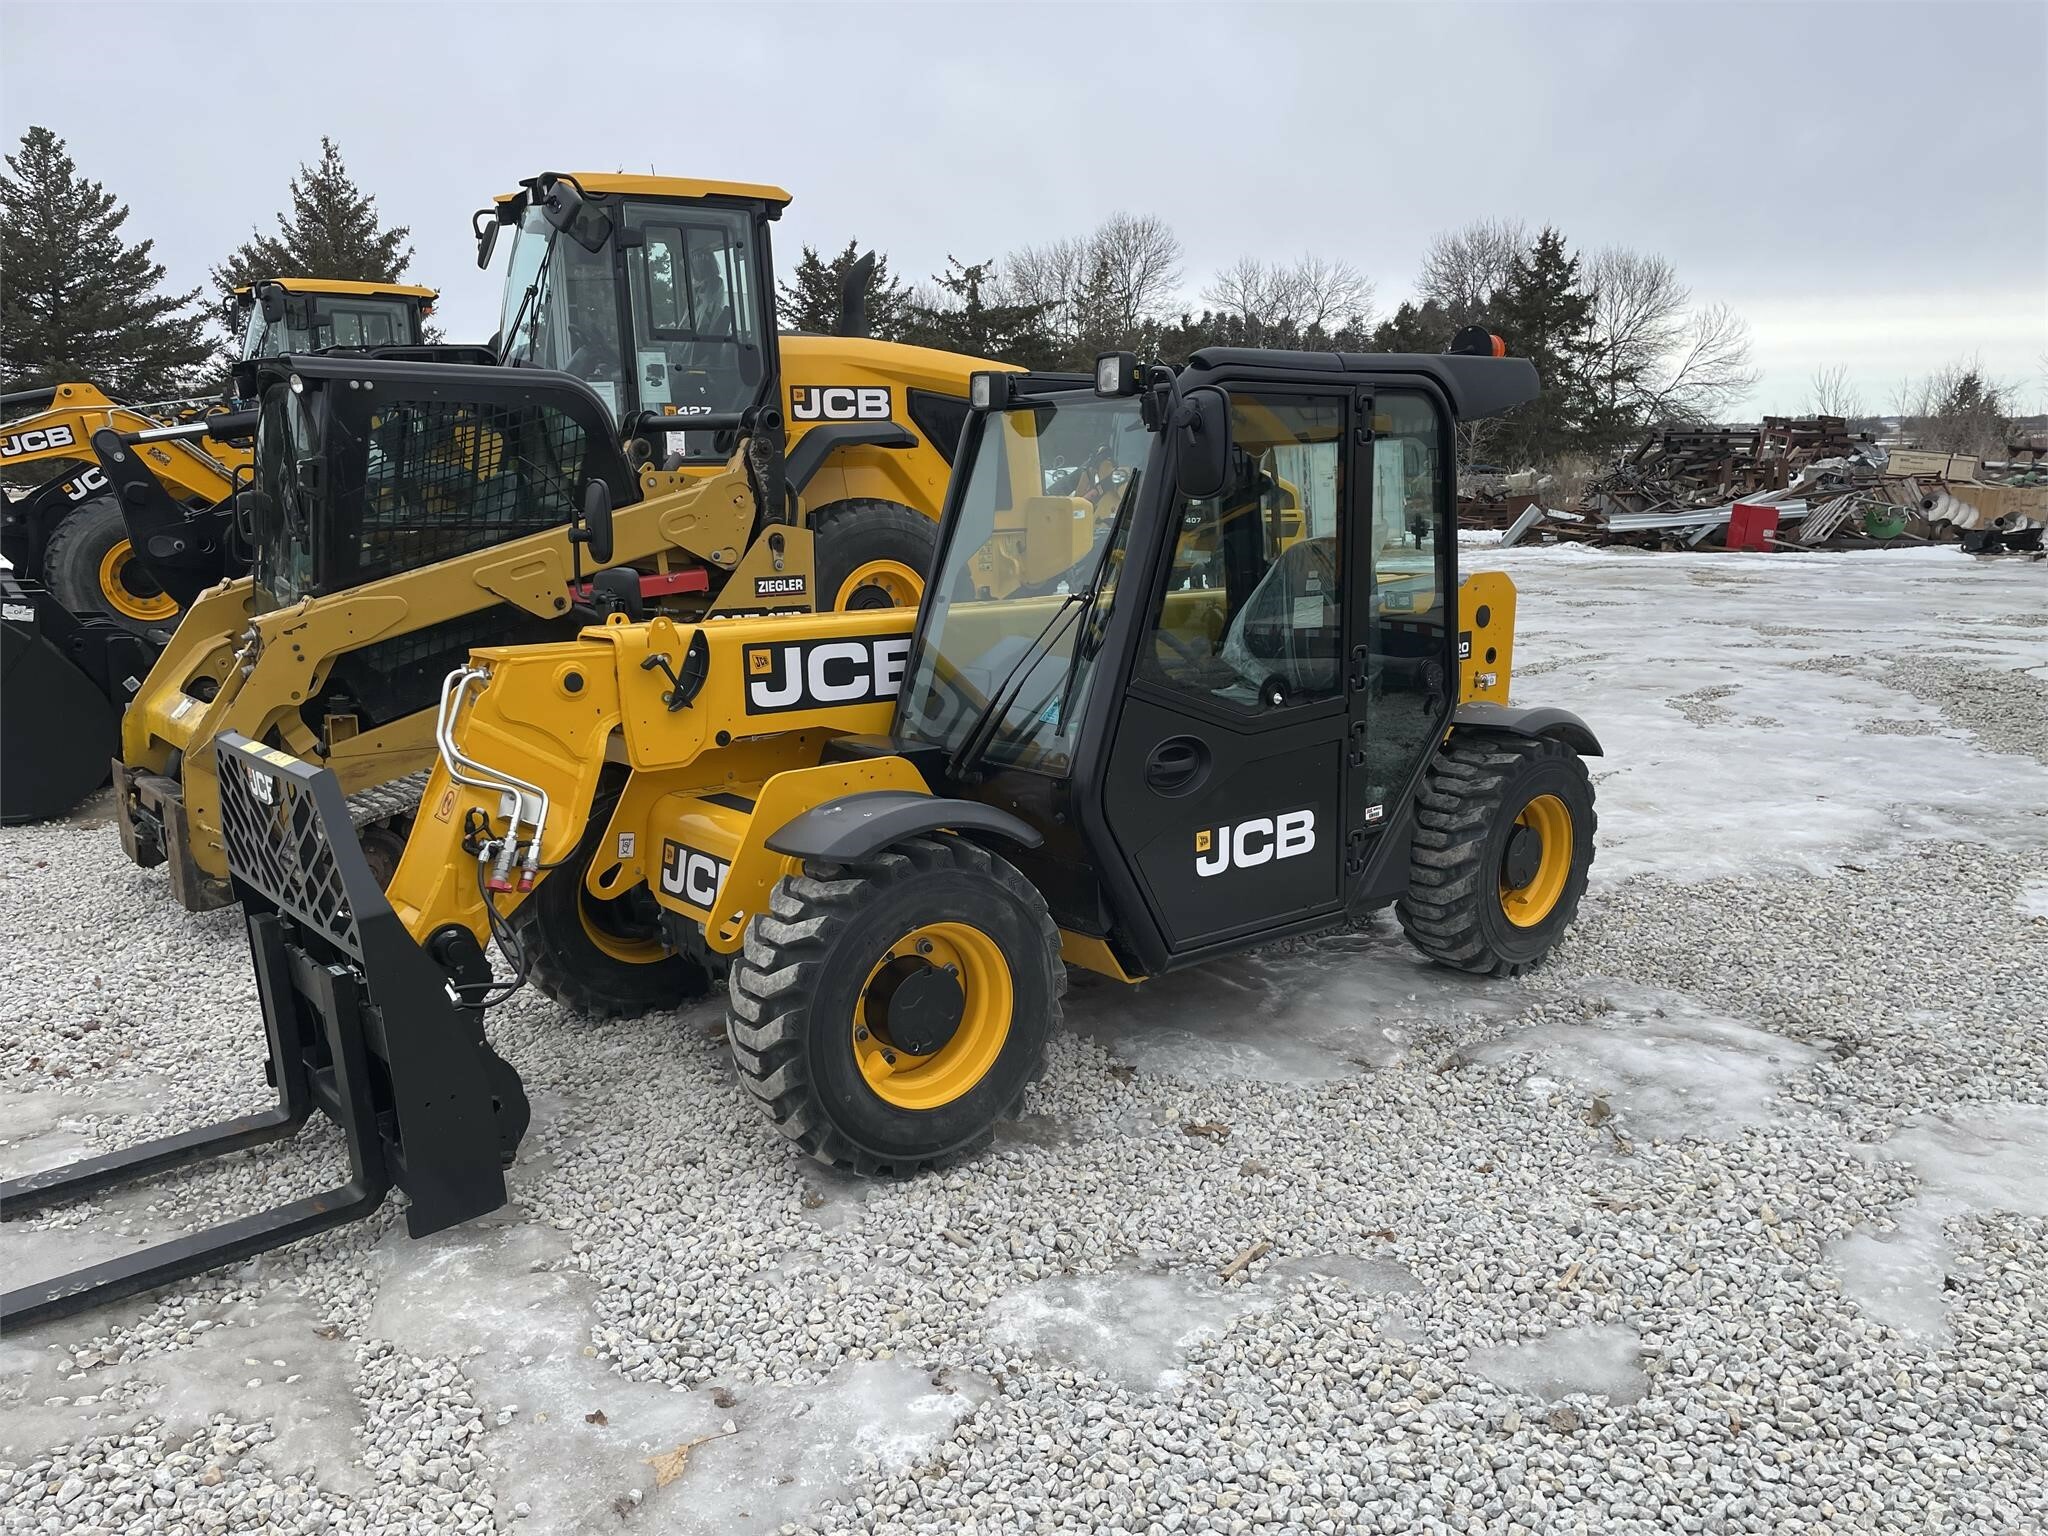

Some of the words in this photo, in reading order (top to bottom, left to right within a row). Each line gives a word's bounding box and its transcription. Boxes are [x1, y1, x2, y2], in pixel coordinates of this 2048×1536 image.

[793, 388, 890, 419] JCB
[1, 426, 73, 456] JCB
[758, 579, 803, 593] ZIEGLER
[1196, 809, 1316, 877] JCB
